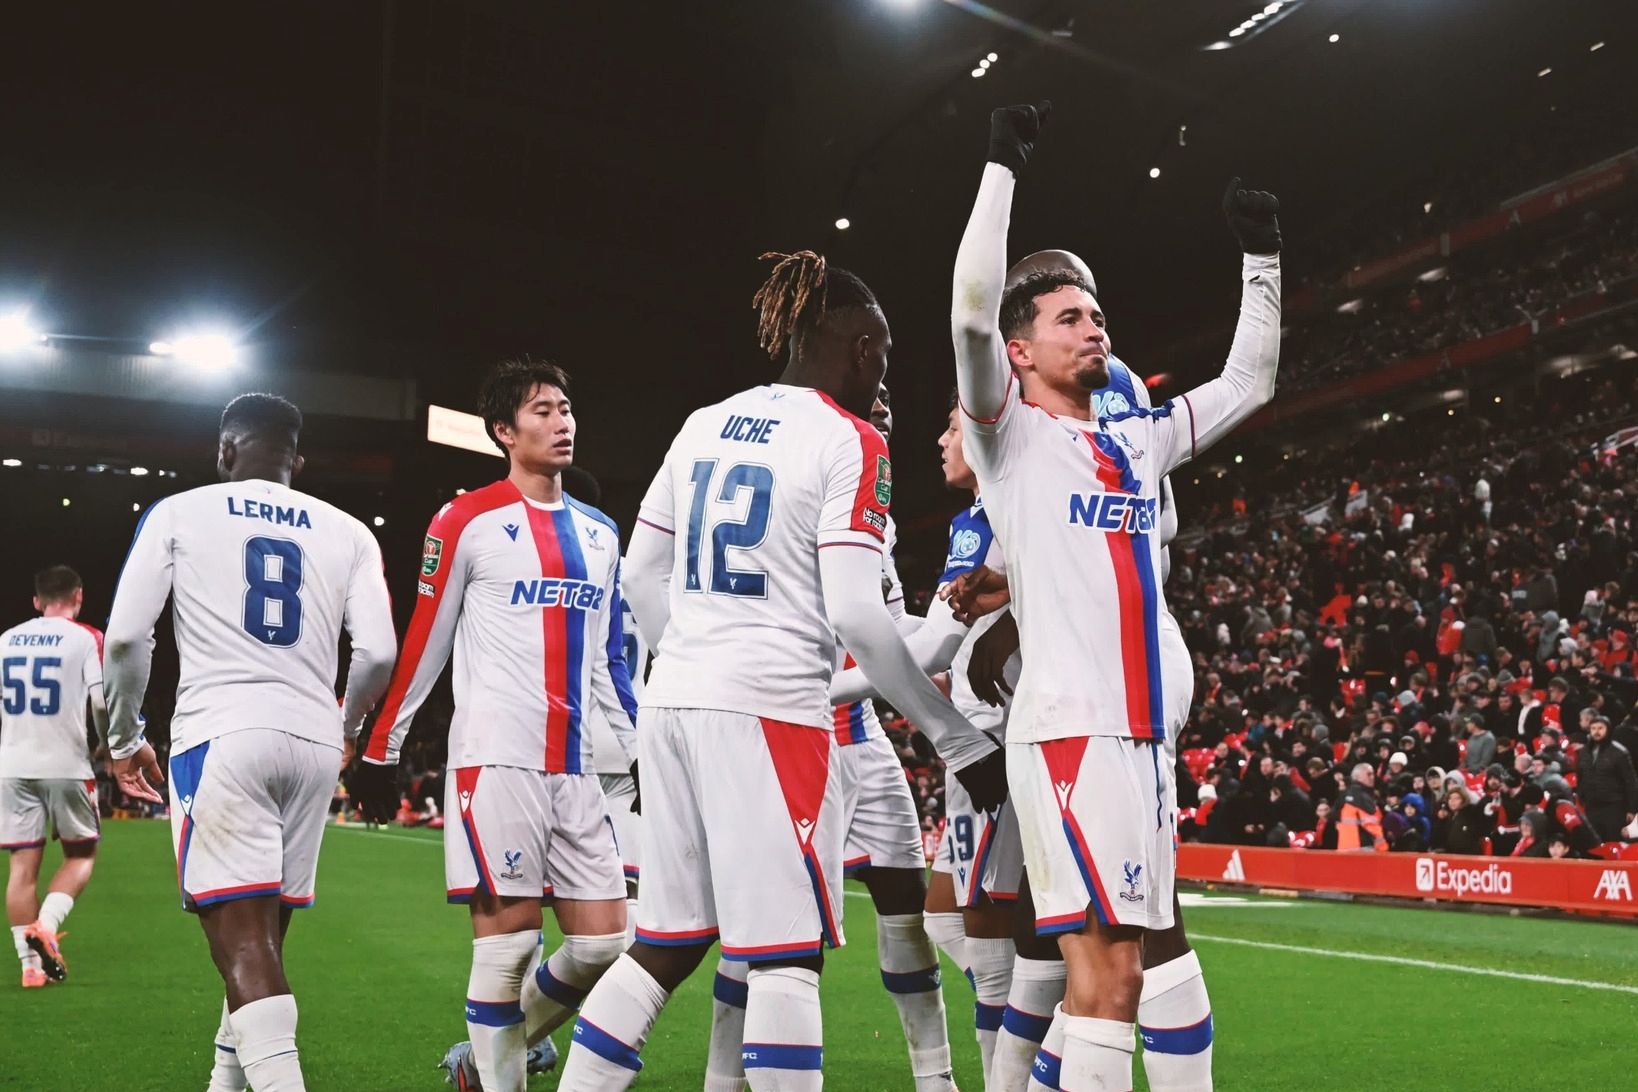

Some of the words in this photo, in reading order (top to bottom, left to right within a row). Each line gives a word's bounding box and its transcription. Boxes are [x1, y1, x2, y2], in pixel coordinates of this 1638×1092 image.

[720, 415, 781, 444] UCHE
[227, 496, 312, 529] LERMA
[684, 458, 776, 600] 12
[241, 533, 305, 649] 8
[9, 634, 64, 647] DEVENNY
[2, 656, 62, 716] 55
[1437, 861, 1512, 896] Expedia
[1593, 869, 1633, 900] AXA
